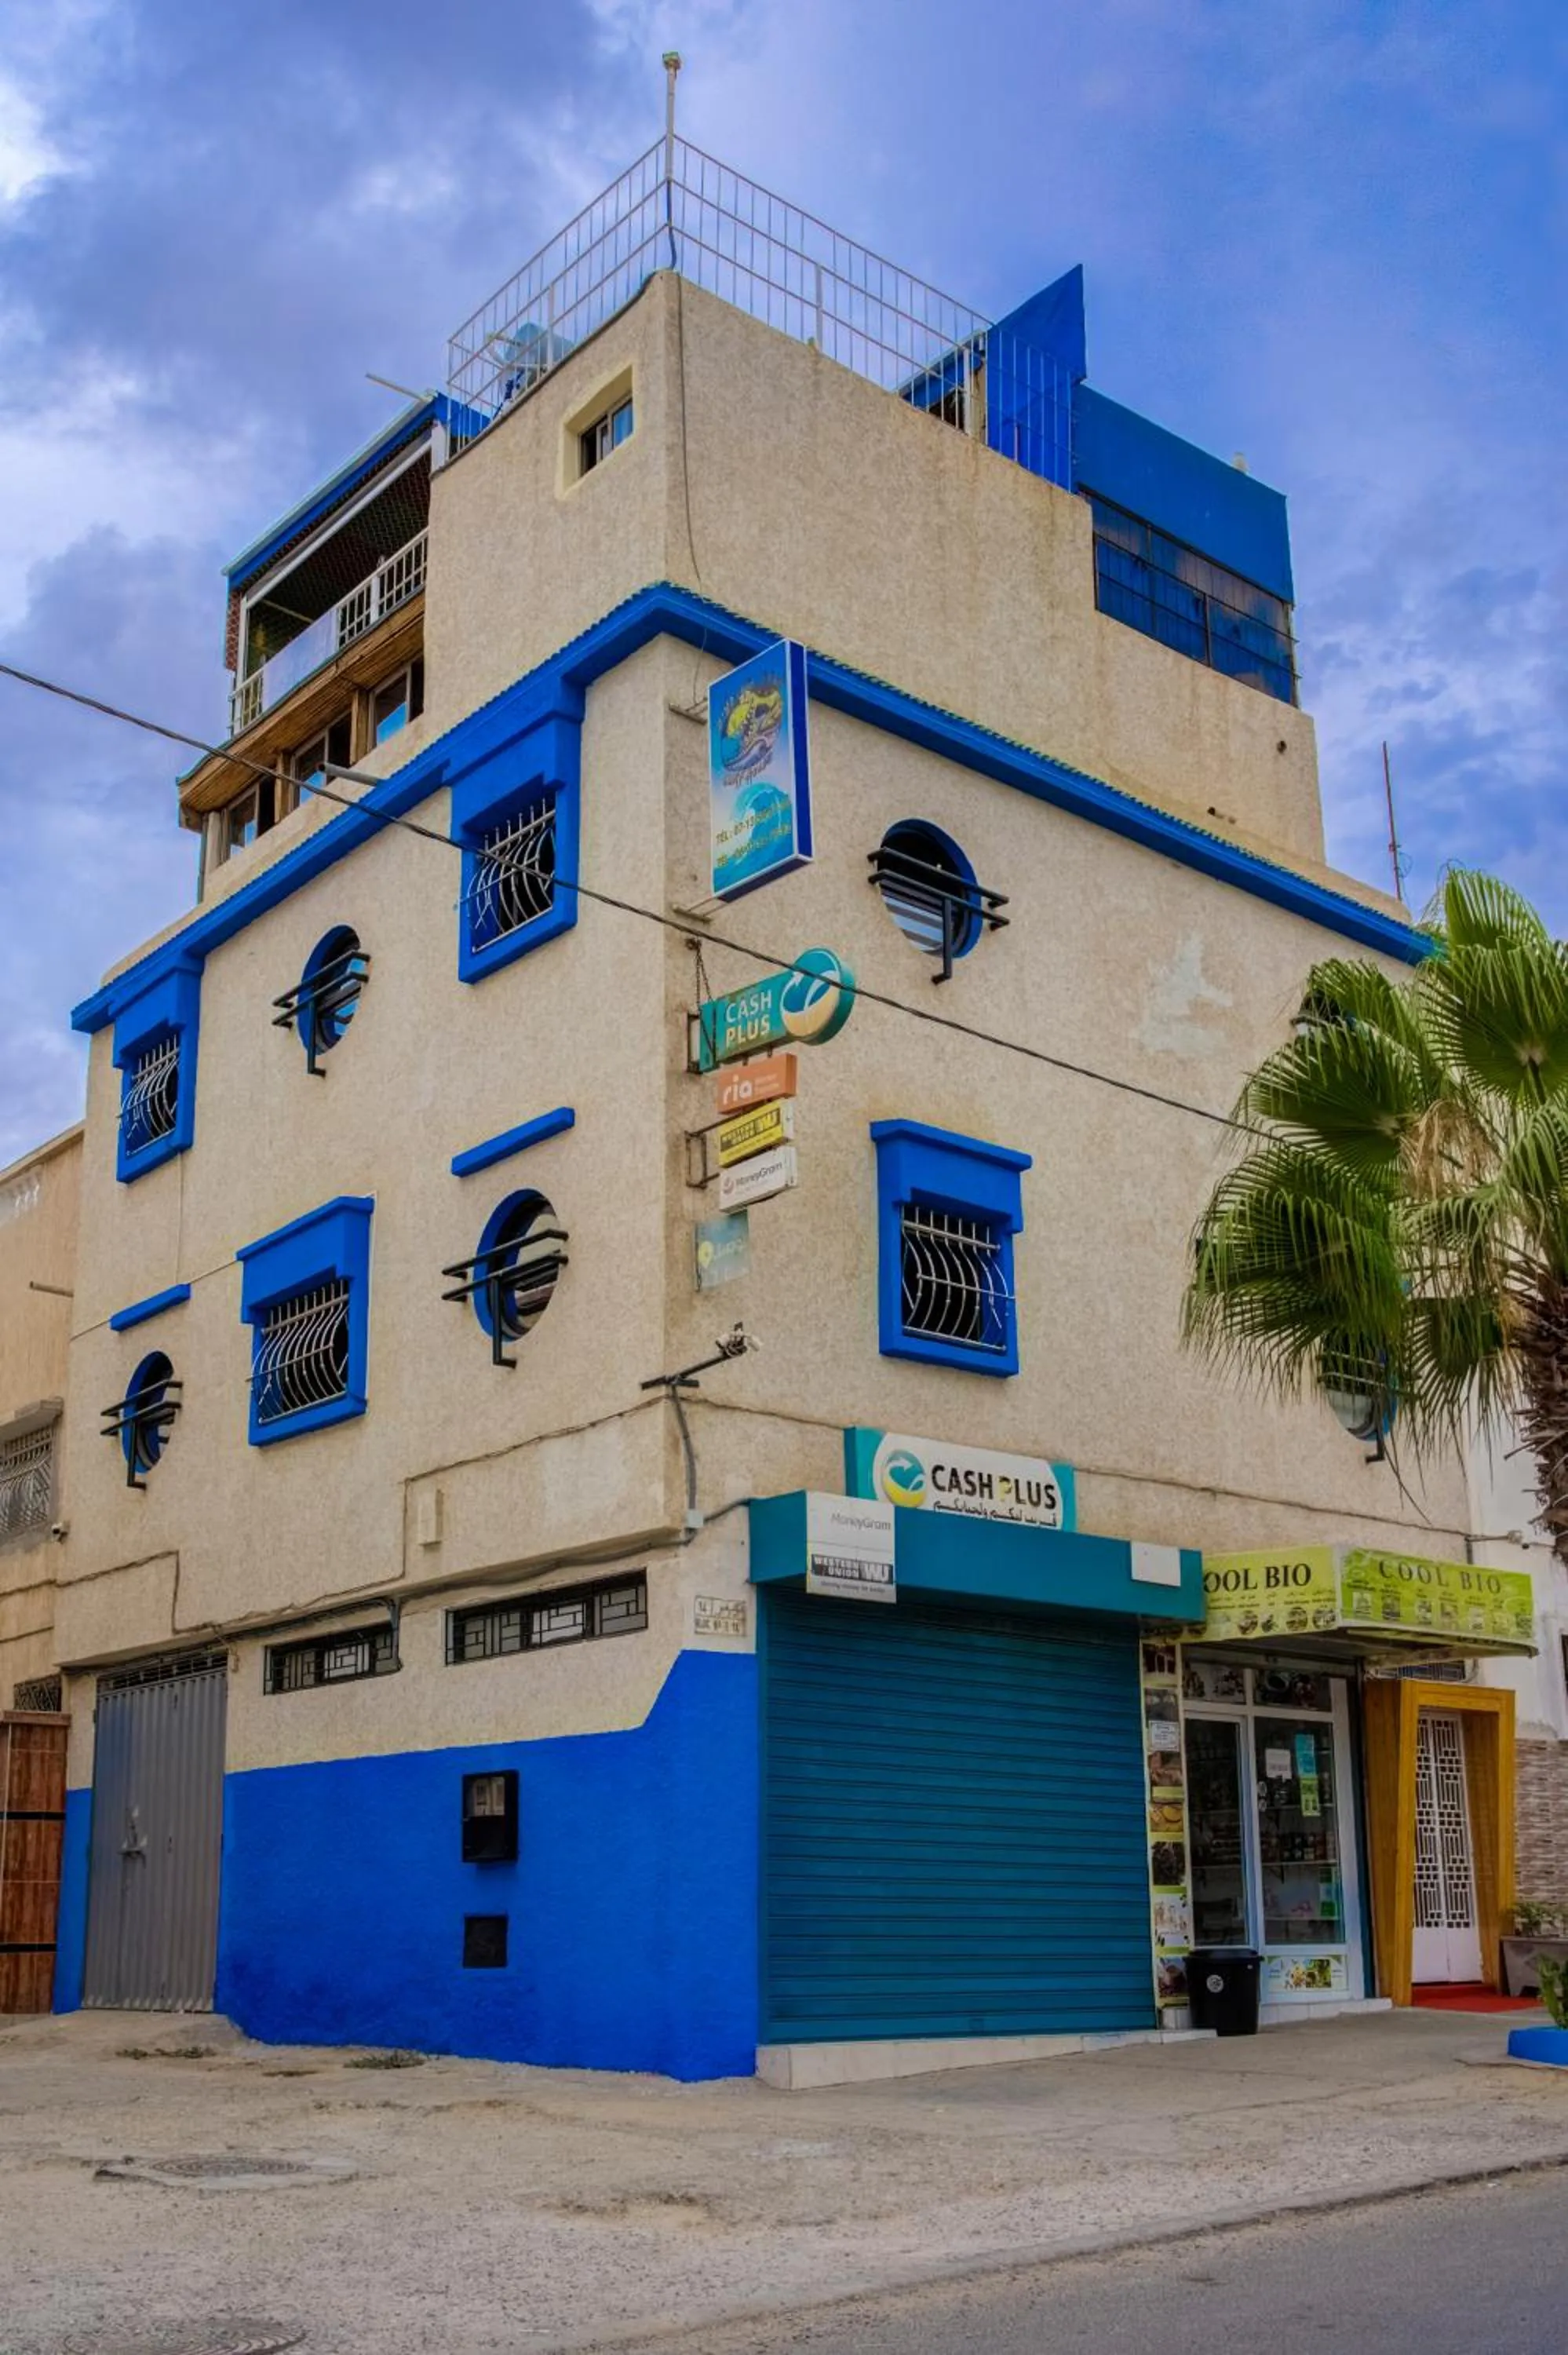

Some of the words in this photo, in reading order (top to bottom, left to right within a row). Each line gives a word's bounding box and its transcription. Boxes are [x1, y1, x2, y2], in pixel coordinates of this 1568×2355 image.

[725, 989, 772, 1024] CASH
[725, 1014, 771, 1047] PLUS
[723, 1074, 753, 1105] ria
[932, 1464, 994, 1499] CASH
[998, 1475, 1057, 1510] PLUS
[831, 1512, 892, 1531] MoneyGram
[1203, 1568, 1258, 1594] OOL
[1264, 1563, 1312, 1590] BIO
[1379, 1560, 1449, 1587] COOL
[1460, 1571, 1501, 1594] BIO
